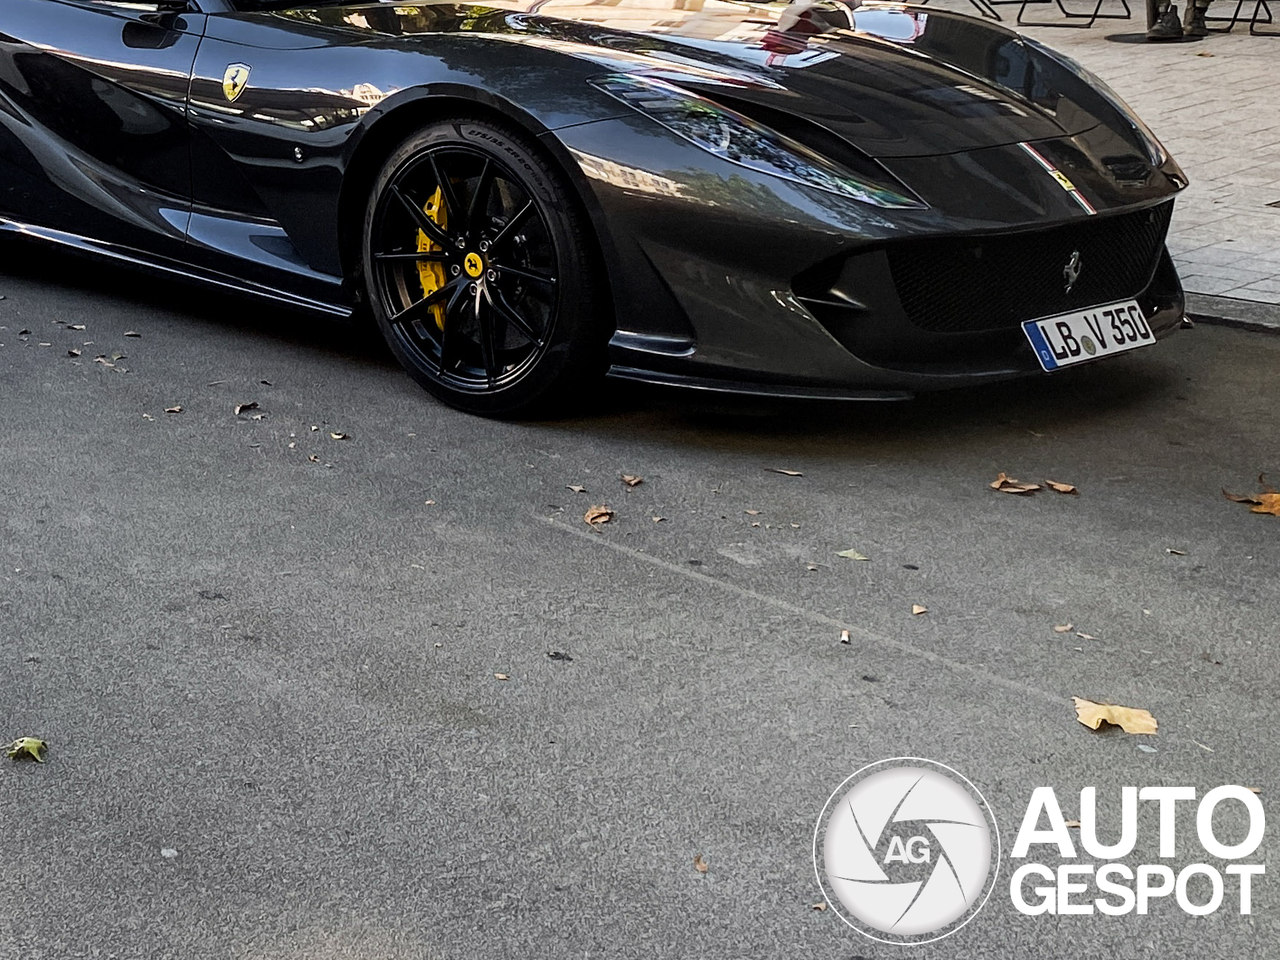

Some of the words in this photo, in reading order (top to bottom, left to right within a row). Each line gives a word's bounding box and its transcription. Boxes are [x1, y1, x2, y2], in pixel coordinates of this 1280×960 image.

[1040, 321, 1081, 360] LB
[1083, 313, 1108, 349] V
[1102, 305, 1150, 345] 350
[1040, 350, 1050, 360] D
